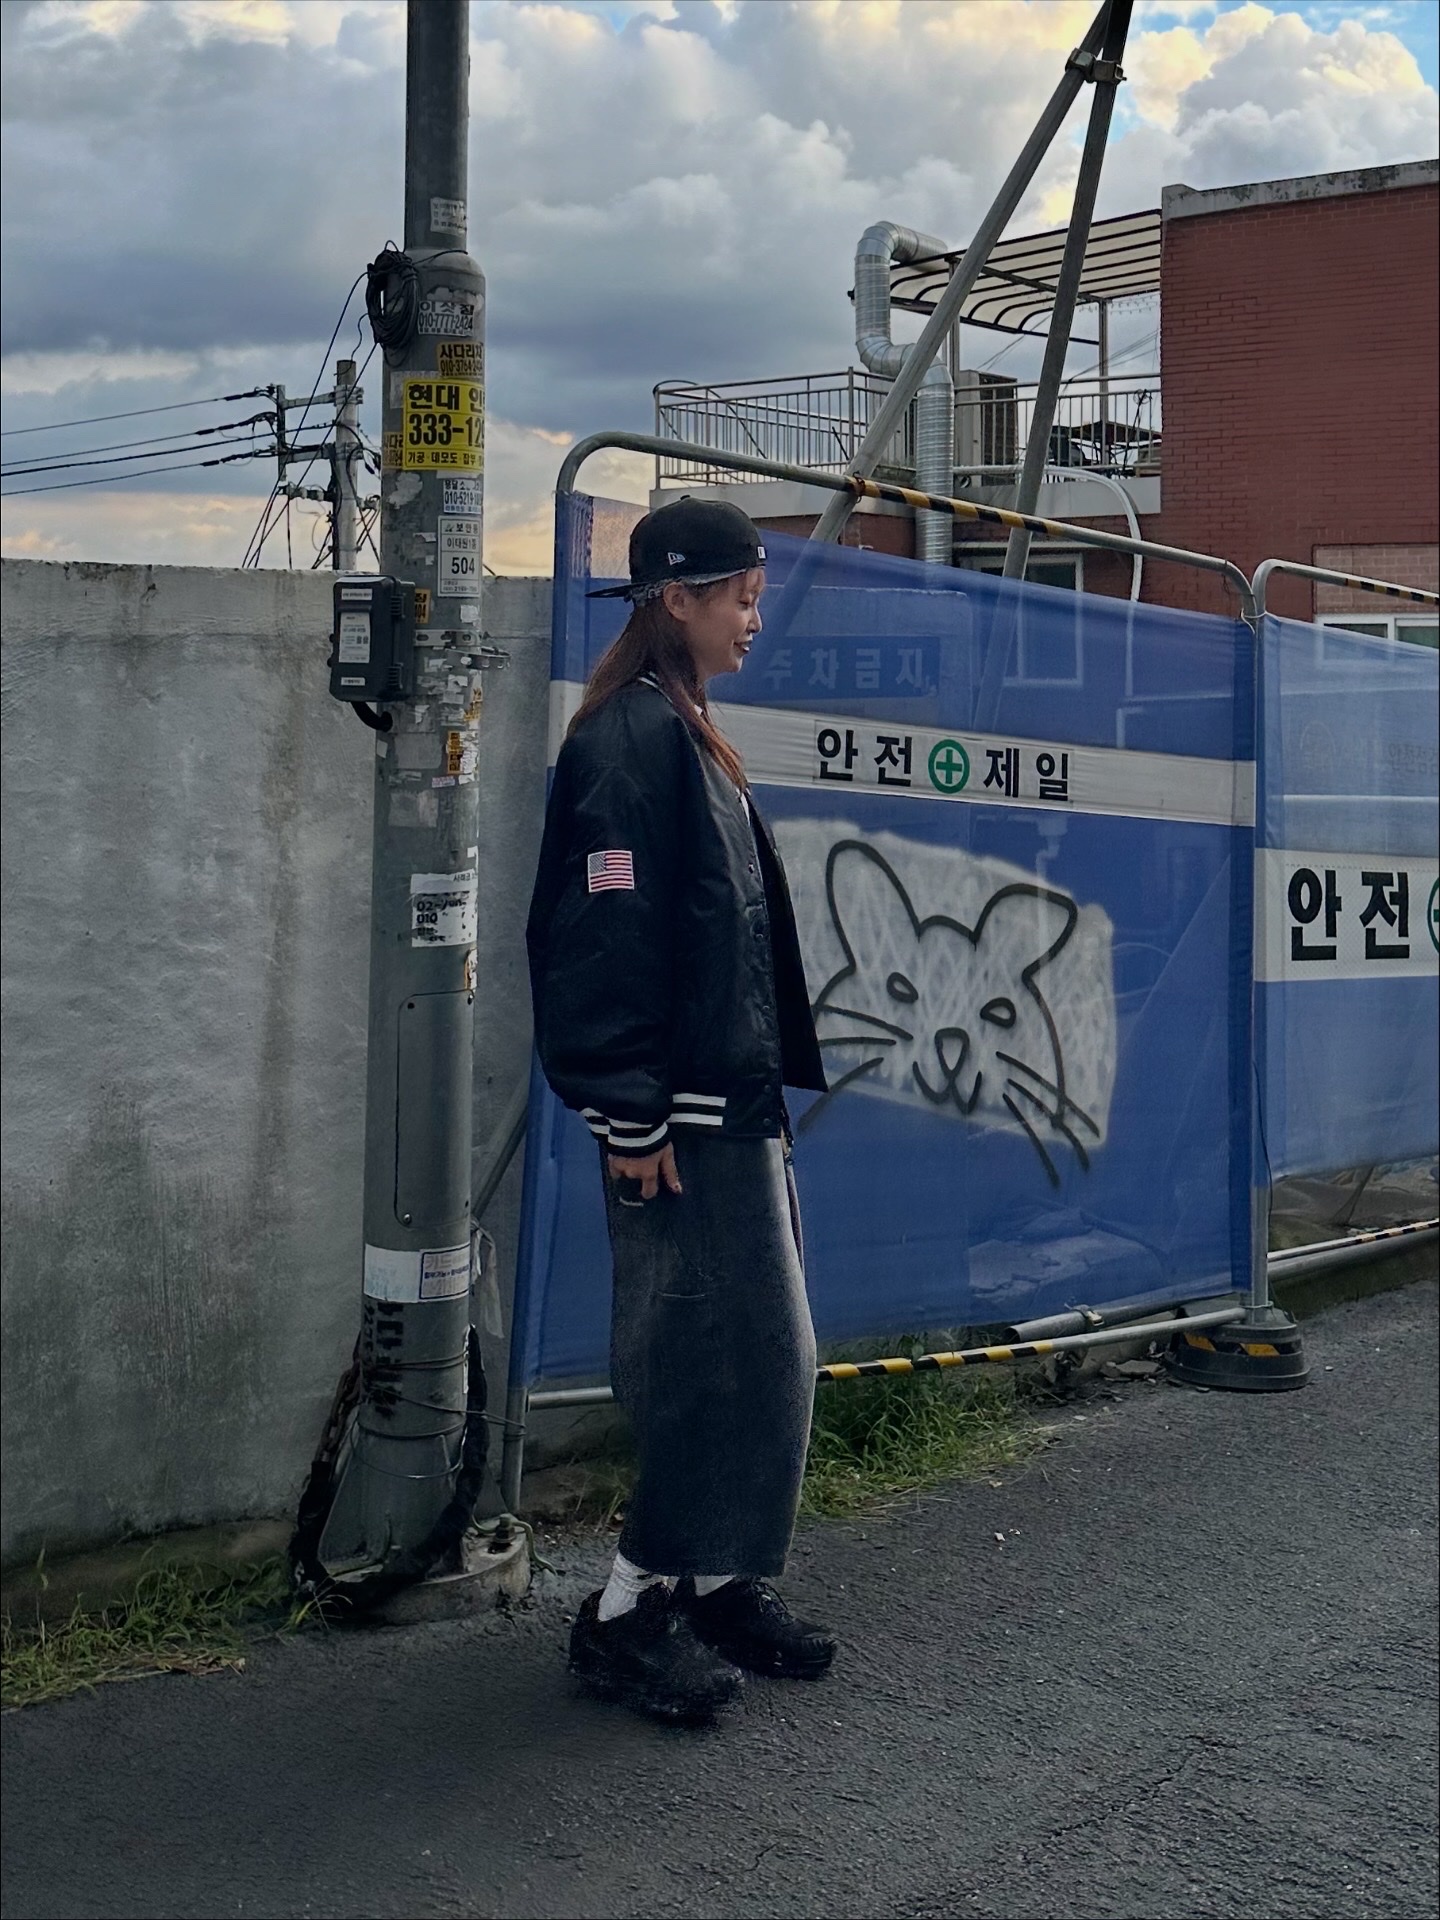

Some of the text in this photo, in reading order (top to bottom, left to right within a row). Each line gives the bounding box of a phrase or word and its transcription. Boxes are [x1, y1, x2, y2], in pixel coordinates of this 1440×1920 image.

[408, 383, 485, 413] 현대 인
[451, 556, 475, 575] 504
[816, 728, 1070, 802] 안전 제일
[1287, 867, 1410, 961] 안전
